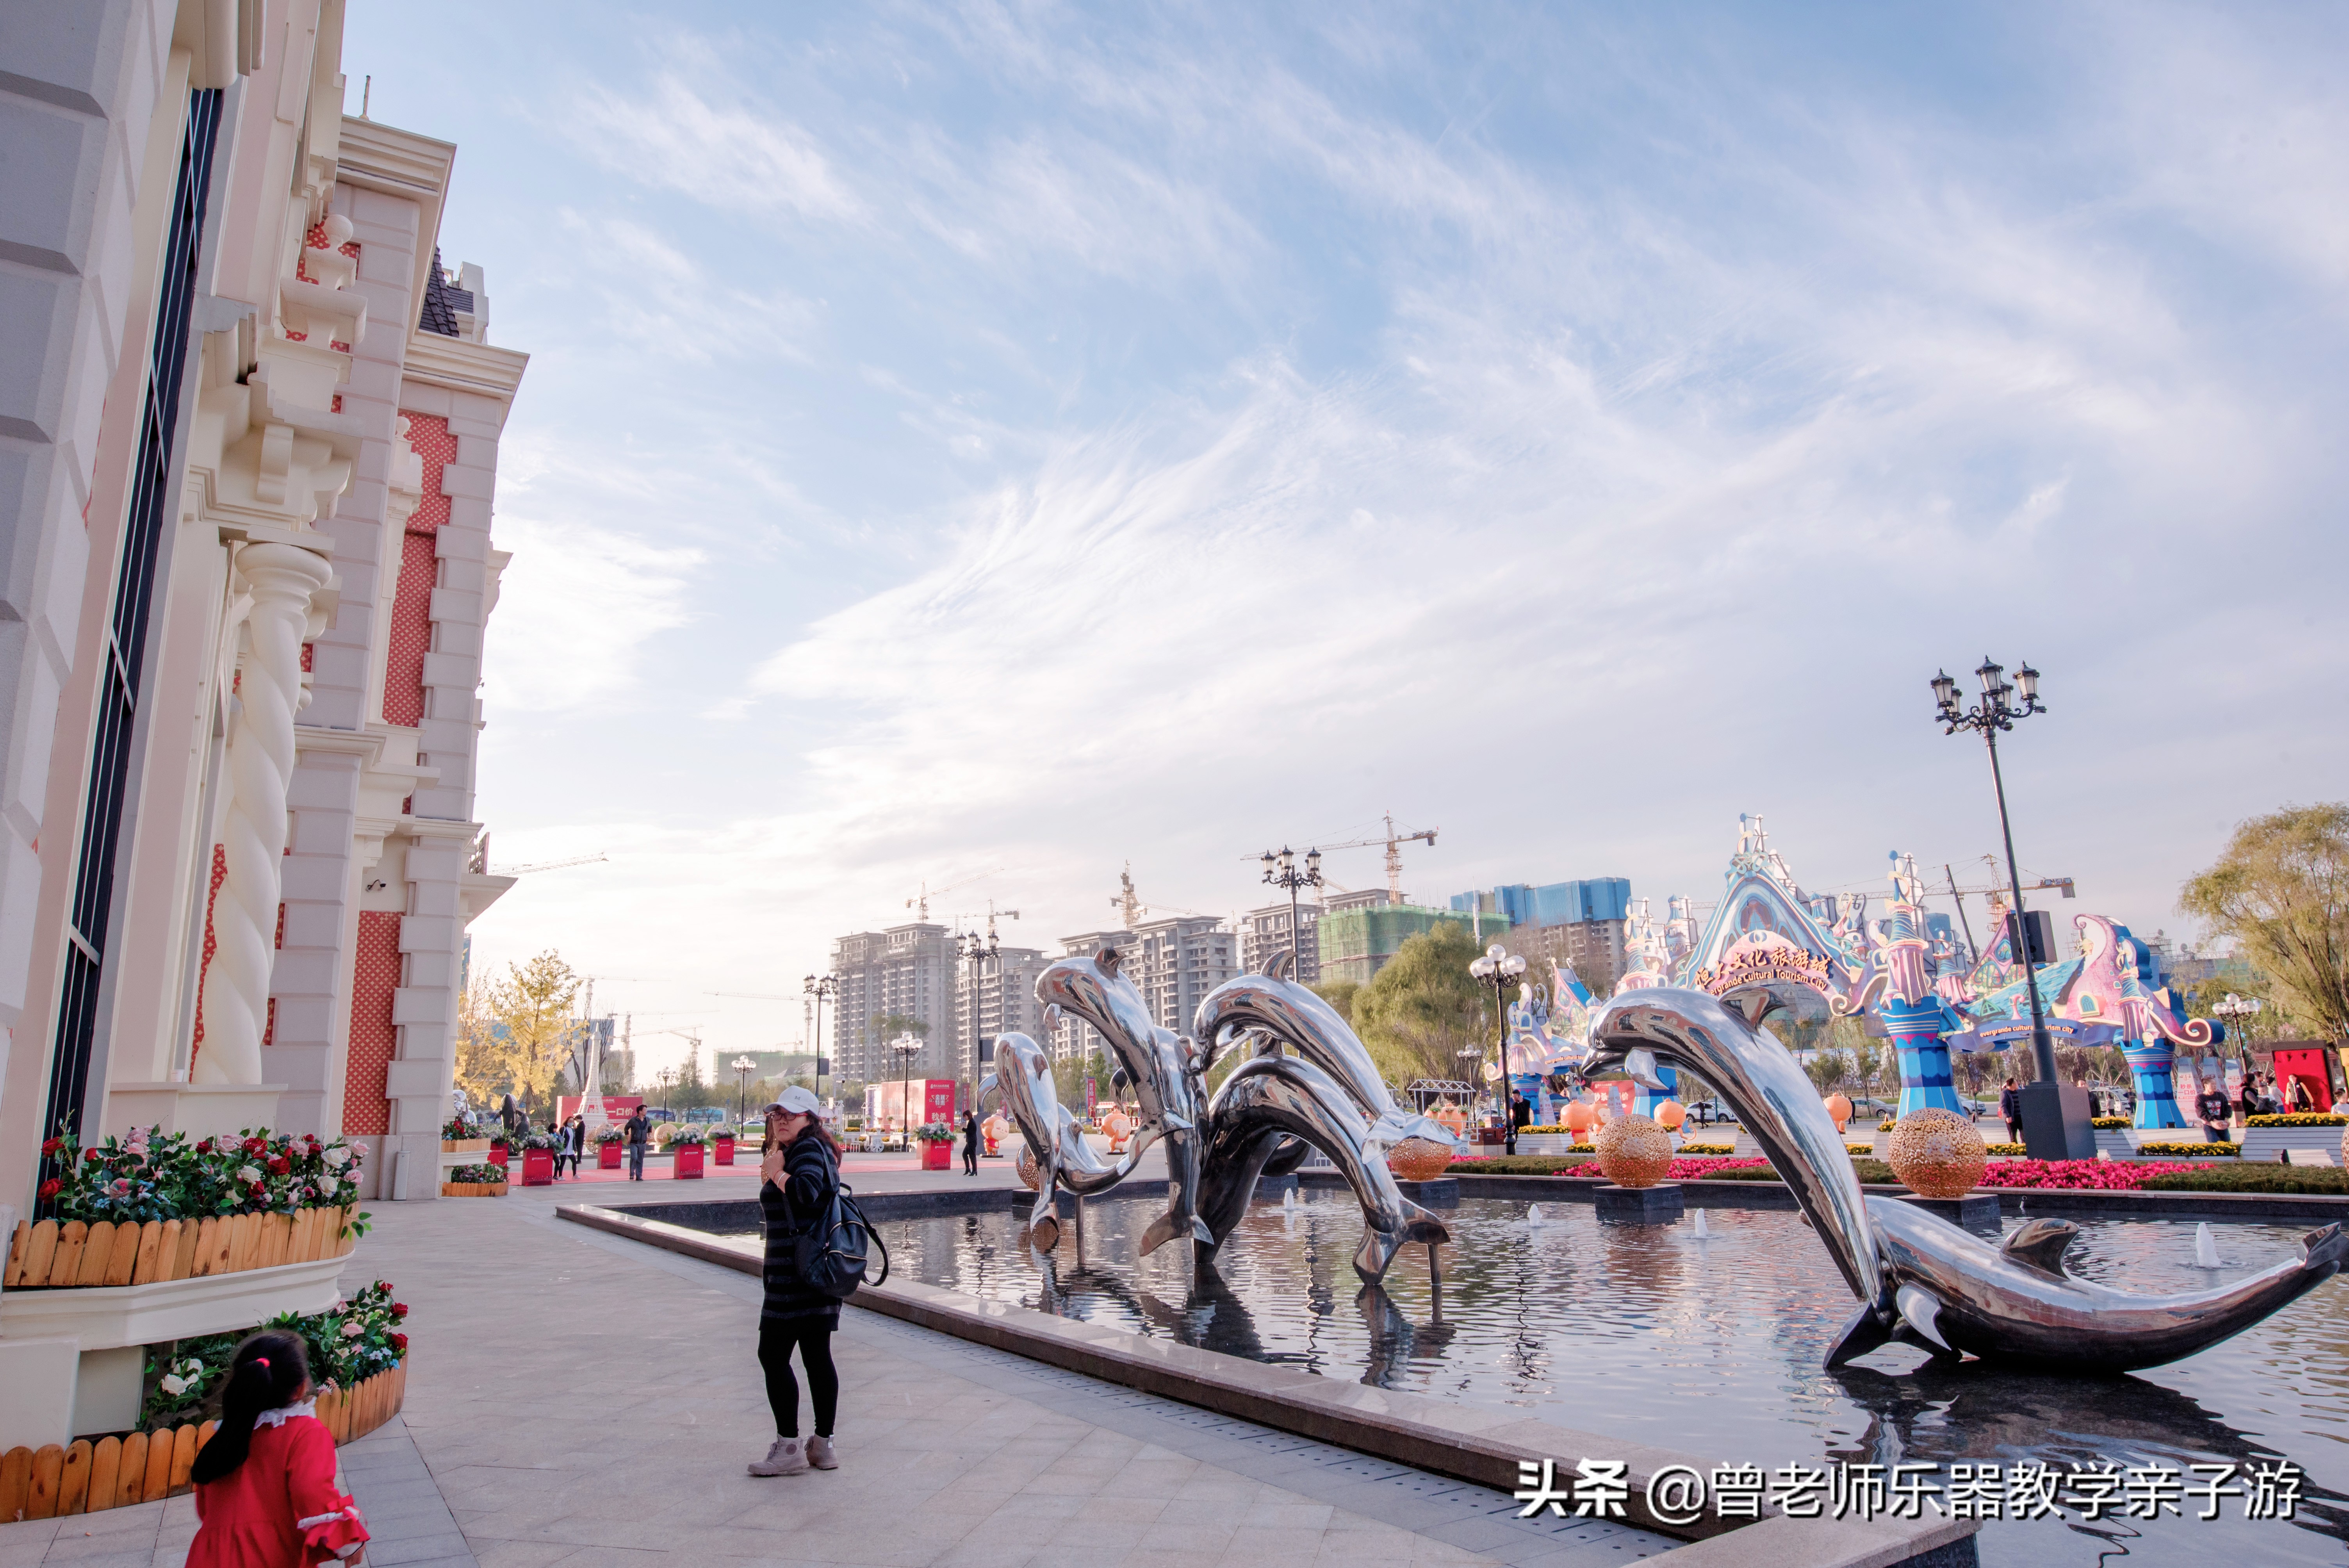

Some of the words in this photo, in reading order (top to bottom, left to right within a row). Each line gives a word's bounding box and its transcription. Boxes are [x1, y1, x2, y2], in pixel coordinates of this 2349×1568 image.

[1695, 946, 1832, 989] 恒大文化旅游城
[1708, 976, 1742, 997] ergrande
[1743, 969, 1774, 982] Cultural
[1776, 969, 1808, 983] Tourism
[1809, 978, 1827, 992] City
[1980, 1026, 2012, 1037] evergrande
[2062, 1026, 2074, 1034] city
[1545, 1056, 1563, 1064] evergrande
